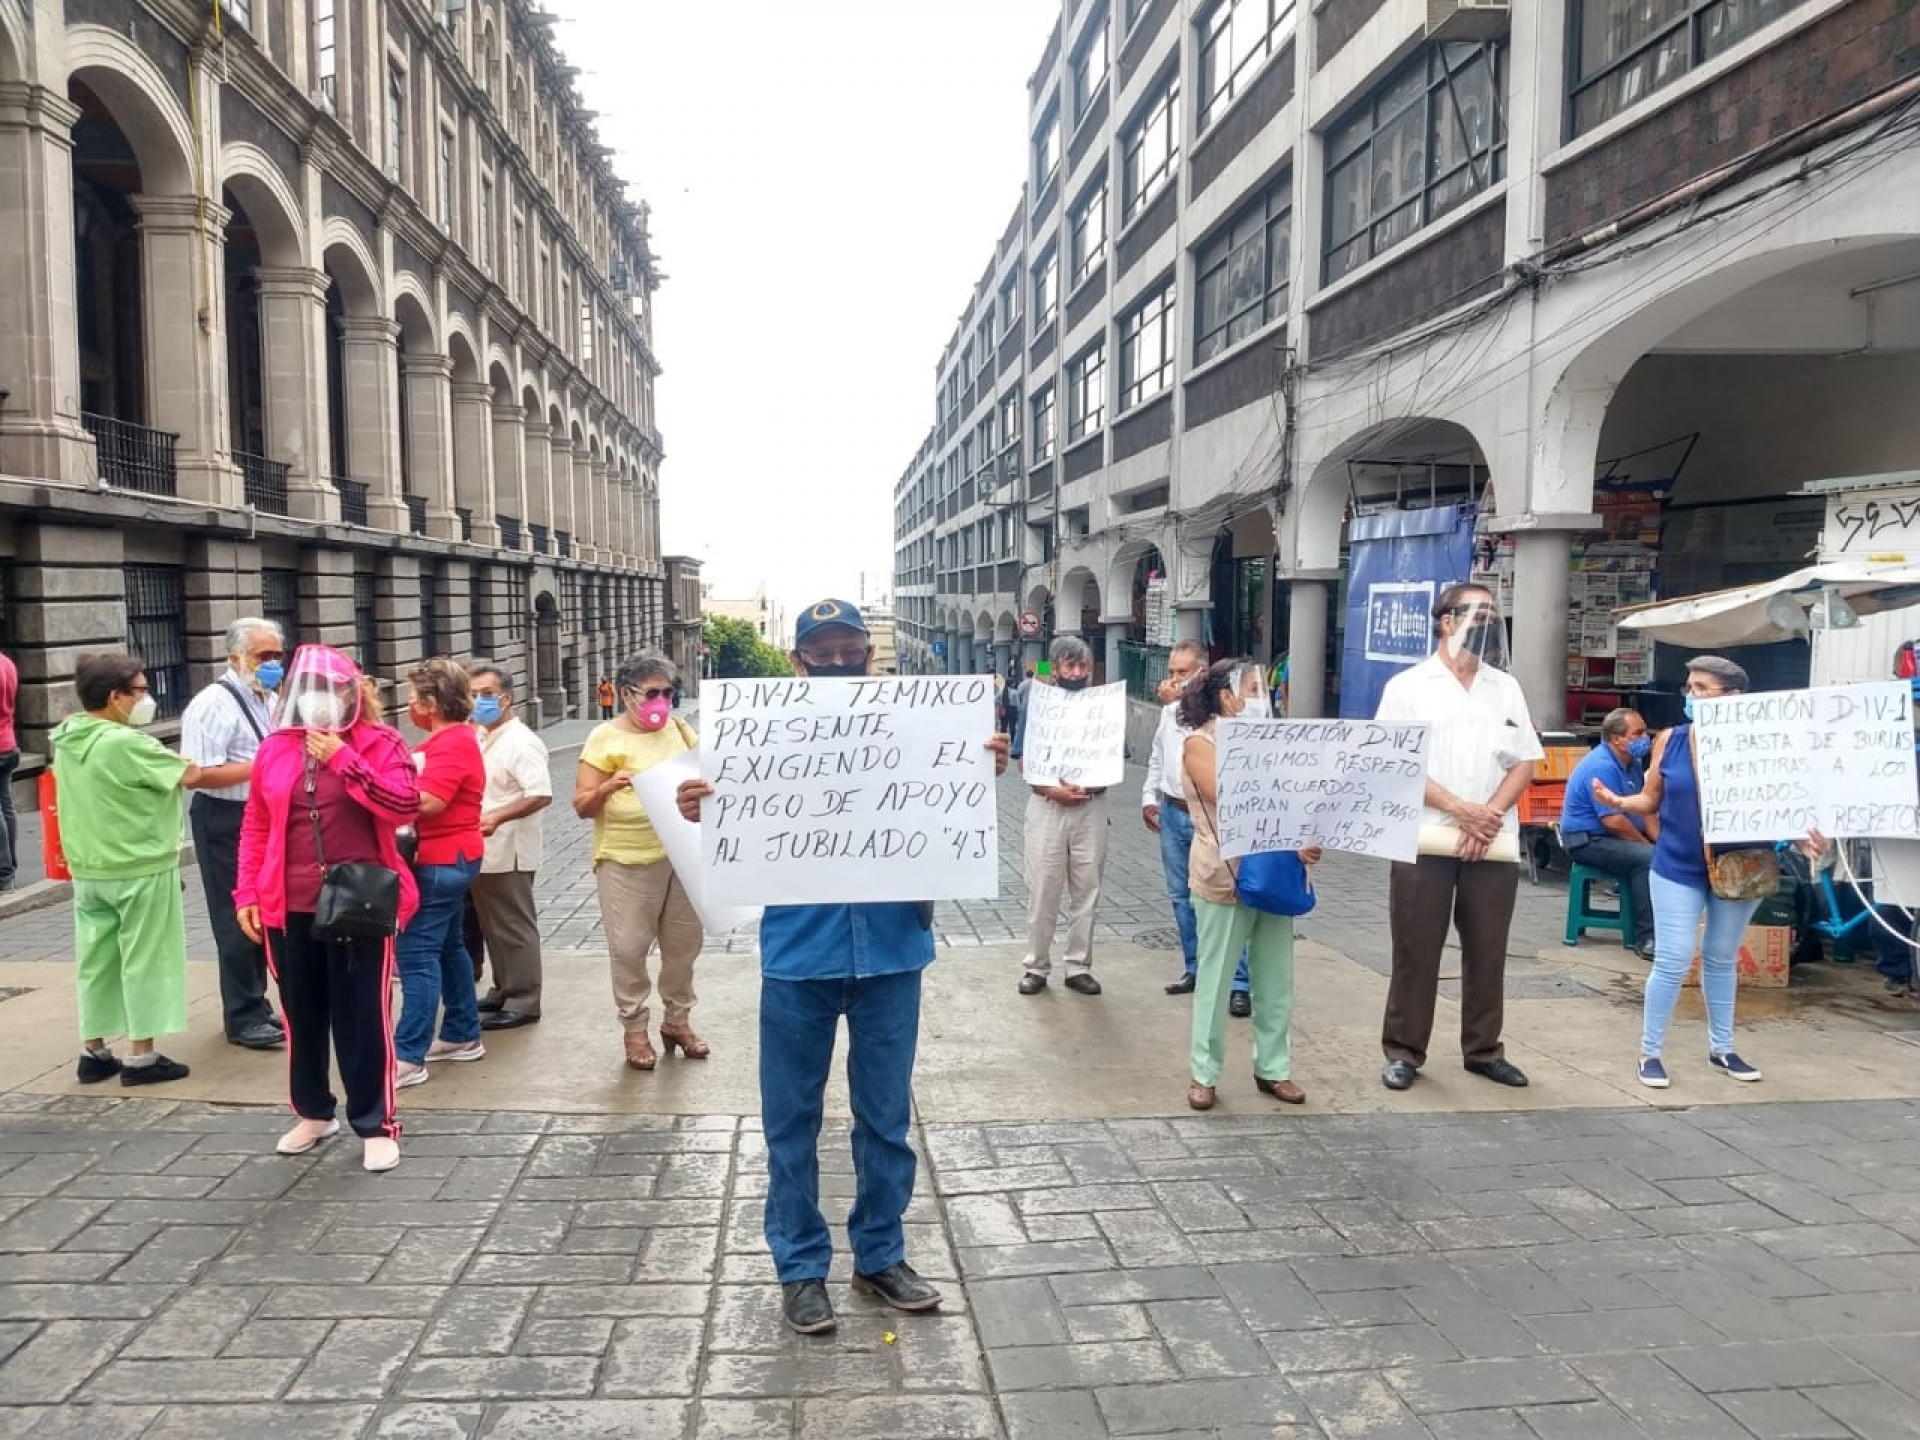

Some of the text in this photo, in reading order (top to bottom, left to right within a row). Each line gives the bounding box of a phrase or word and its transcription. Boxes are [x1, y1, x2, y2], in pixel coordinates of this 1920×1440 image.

[847, 680, 985, 709] TEMIXCO
[1700, 692, 1906, 727] DELEGACIÓN D-IV-1
[714, 713, 894, 750] PRESENTE,
[1227, 721, 1353, 746] DELEGACIÓN
[1734, 731, 1794, 752] BASTA
[1808, 730, 1836, 751] DE
[1853, 729, 1913, 751] BURLAS
[714, 740, 976, 785] EXIGIENDO EL
[1335, 751, 1420, 778] RESPETO
[1721, 756, 1810, 779] MENTIRAS
[1832, 754, 1845, 775] A
[1869, 761, 1906, 778] LOS
[1231, 779, 1261, 795] LOS
[1706, 781, 1809, 805] JUBILADOS
[716, 781, 986, 828] PAGO DE APOYO
[1219, 796, 1418, 824] CUMPLAN CON EL PAGO
[1299, 823, 1321, 836] EL
[1357, 821, 1386, 839] DE
[712, 837, 744, 866] AL
[765, 829, 927, 861] JUBILADO
[1250, 838, 1303, 852] AGOSTO
